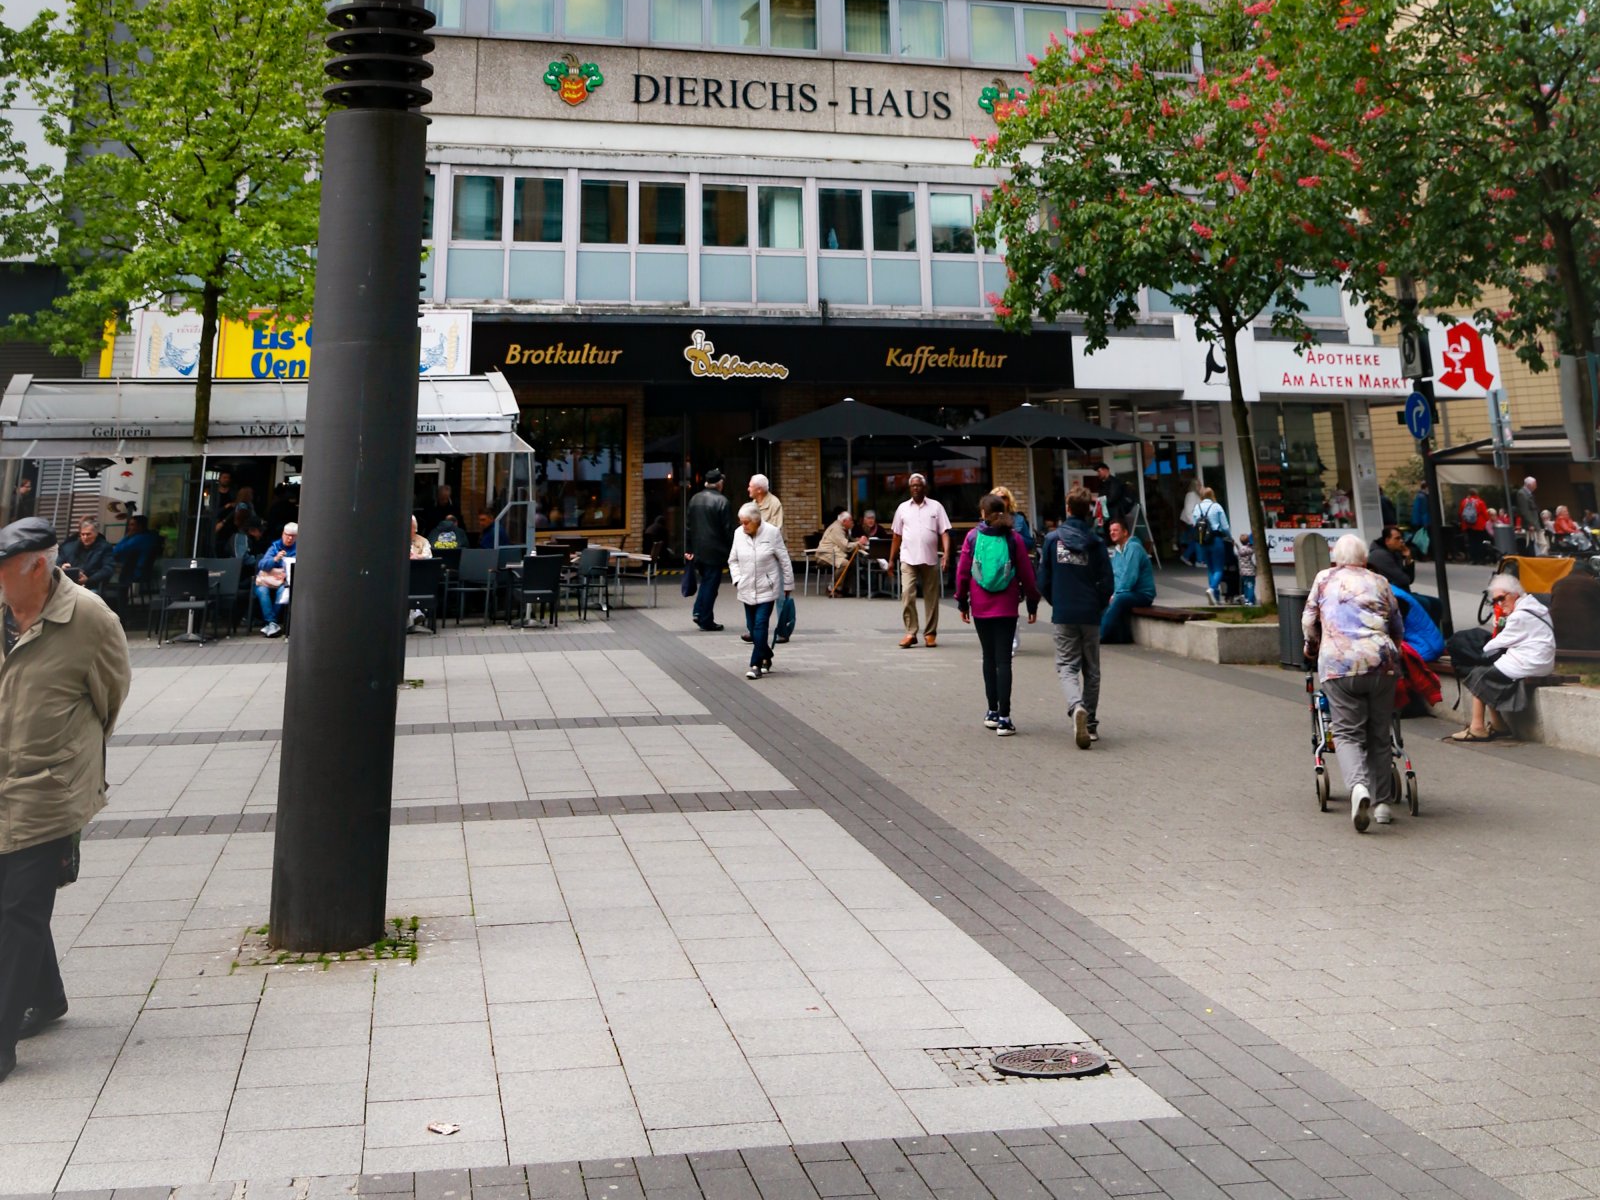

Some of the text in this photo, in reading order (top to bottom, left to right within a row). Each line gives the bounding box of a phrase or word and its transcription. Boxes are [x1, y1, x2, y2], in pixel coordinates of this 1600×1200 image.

[251, 352, 306, 379] Ven
[505, 342, 623, 365] Brotkultur
[684, 345, 789, 380] Dahlmann
[885, 346, 1008, 374] Kaffeekultur
[92, 426, 151, 438] Gelateria
